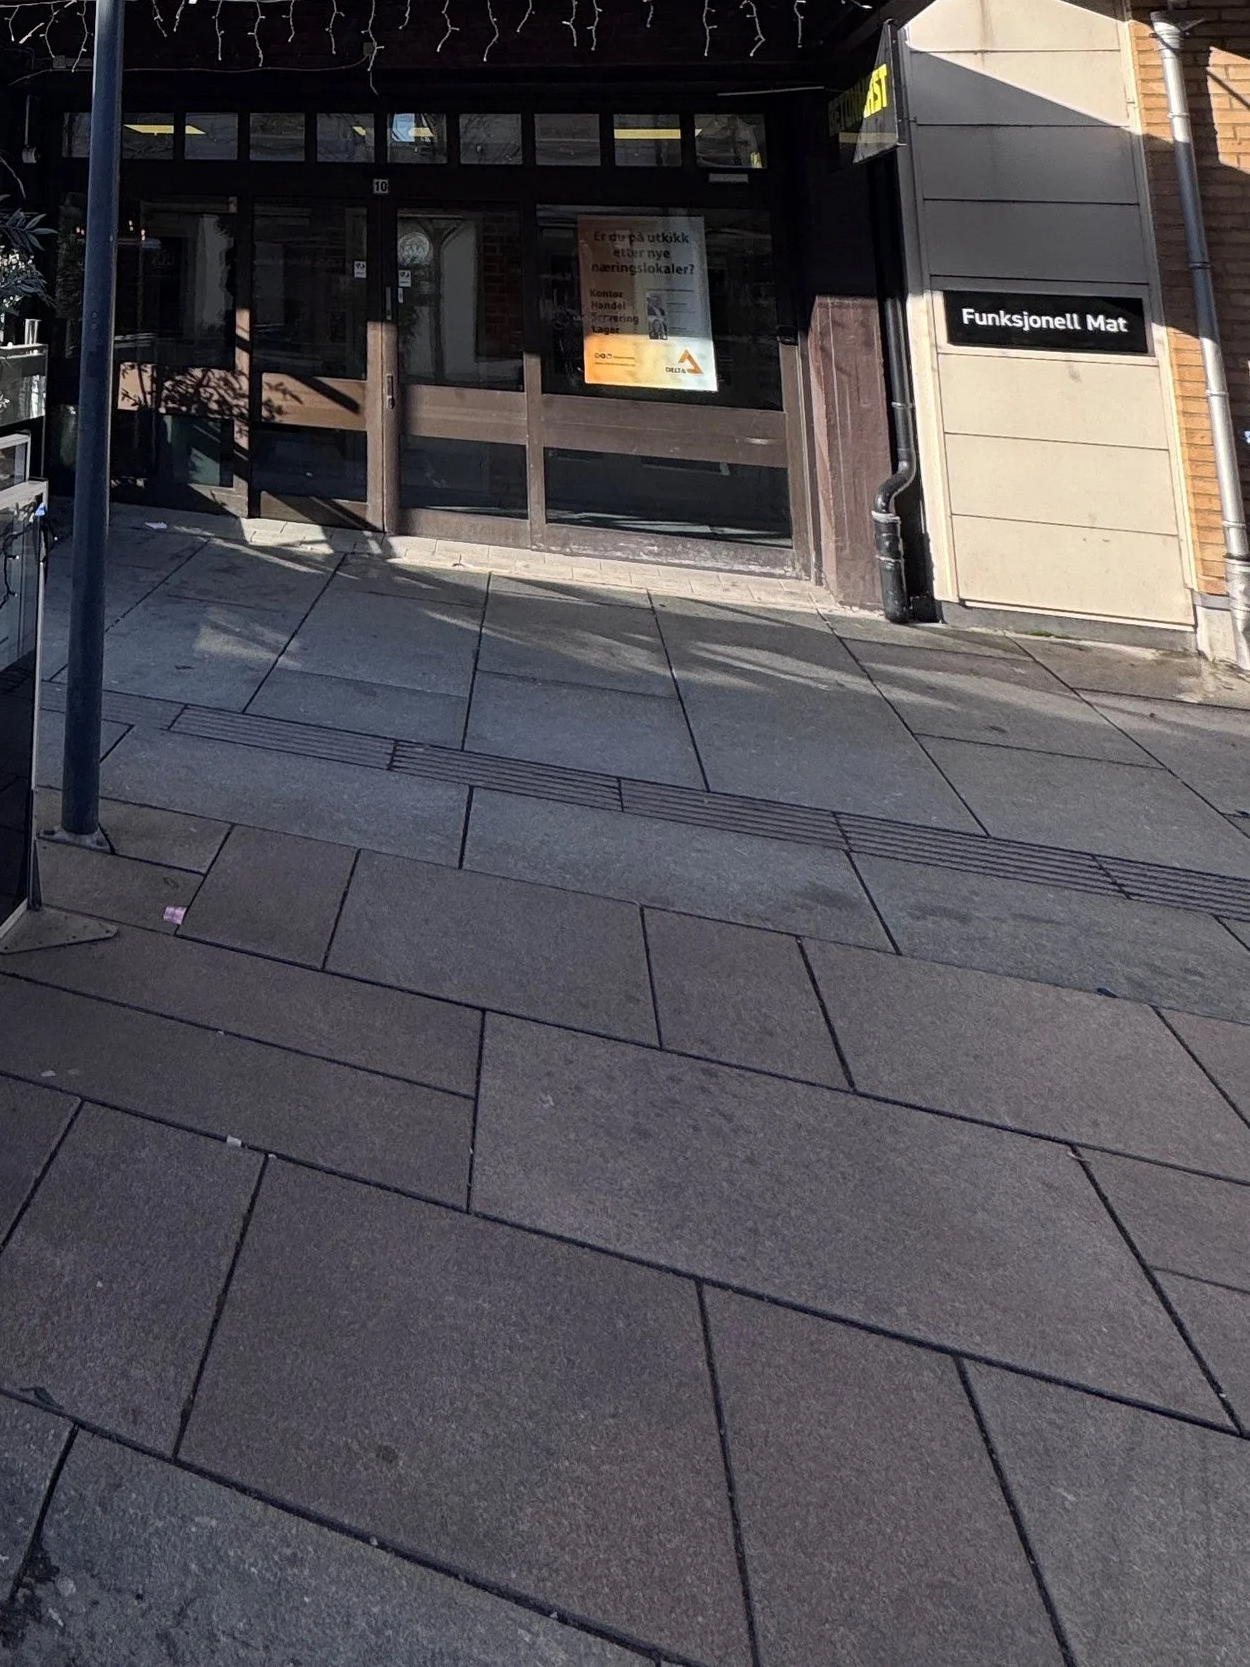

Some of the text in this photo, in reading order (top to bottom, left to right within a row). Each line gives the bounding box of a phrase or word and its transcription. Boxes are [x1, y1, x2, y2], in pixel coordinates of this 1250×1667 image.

[375, 181, 387, 192] 10
[594, 231, 607, 242] Er
[629, 230, 645, 245] på
[647, 231, 690, 244] utkikk
[646, 249, 670, 261] nye
[591, 261, 695, 275] næringslokaler?
[589, 288, 624, 298] Kontor
[590, 300, 626, 310] Handel
[961, 308, 1129, 333] Funksjonell Mat
